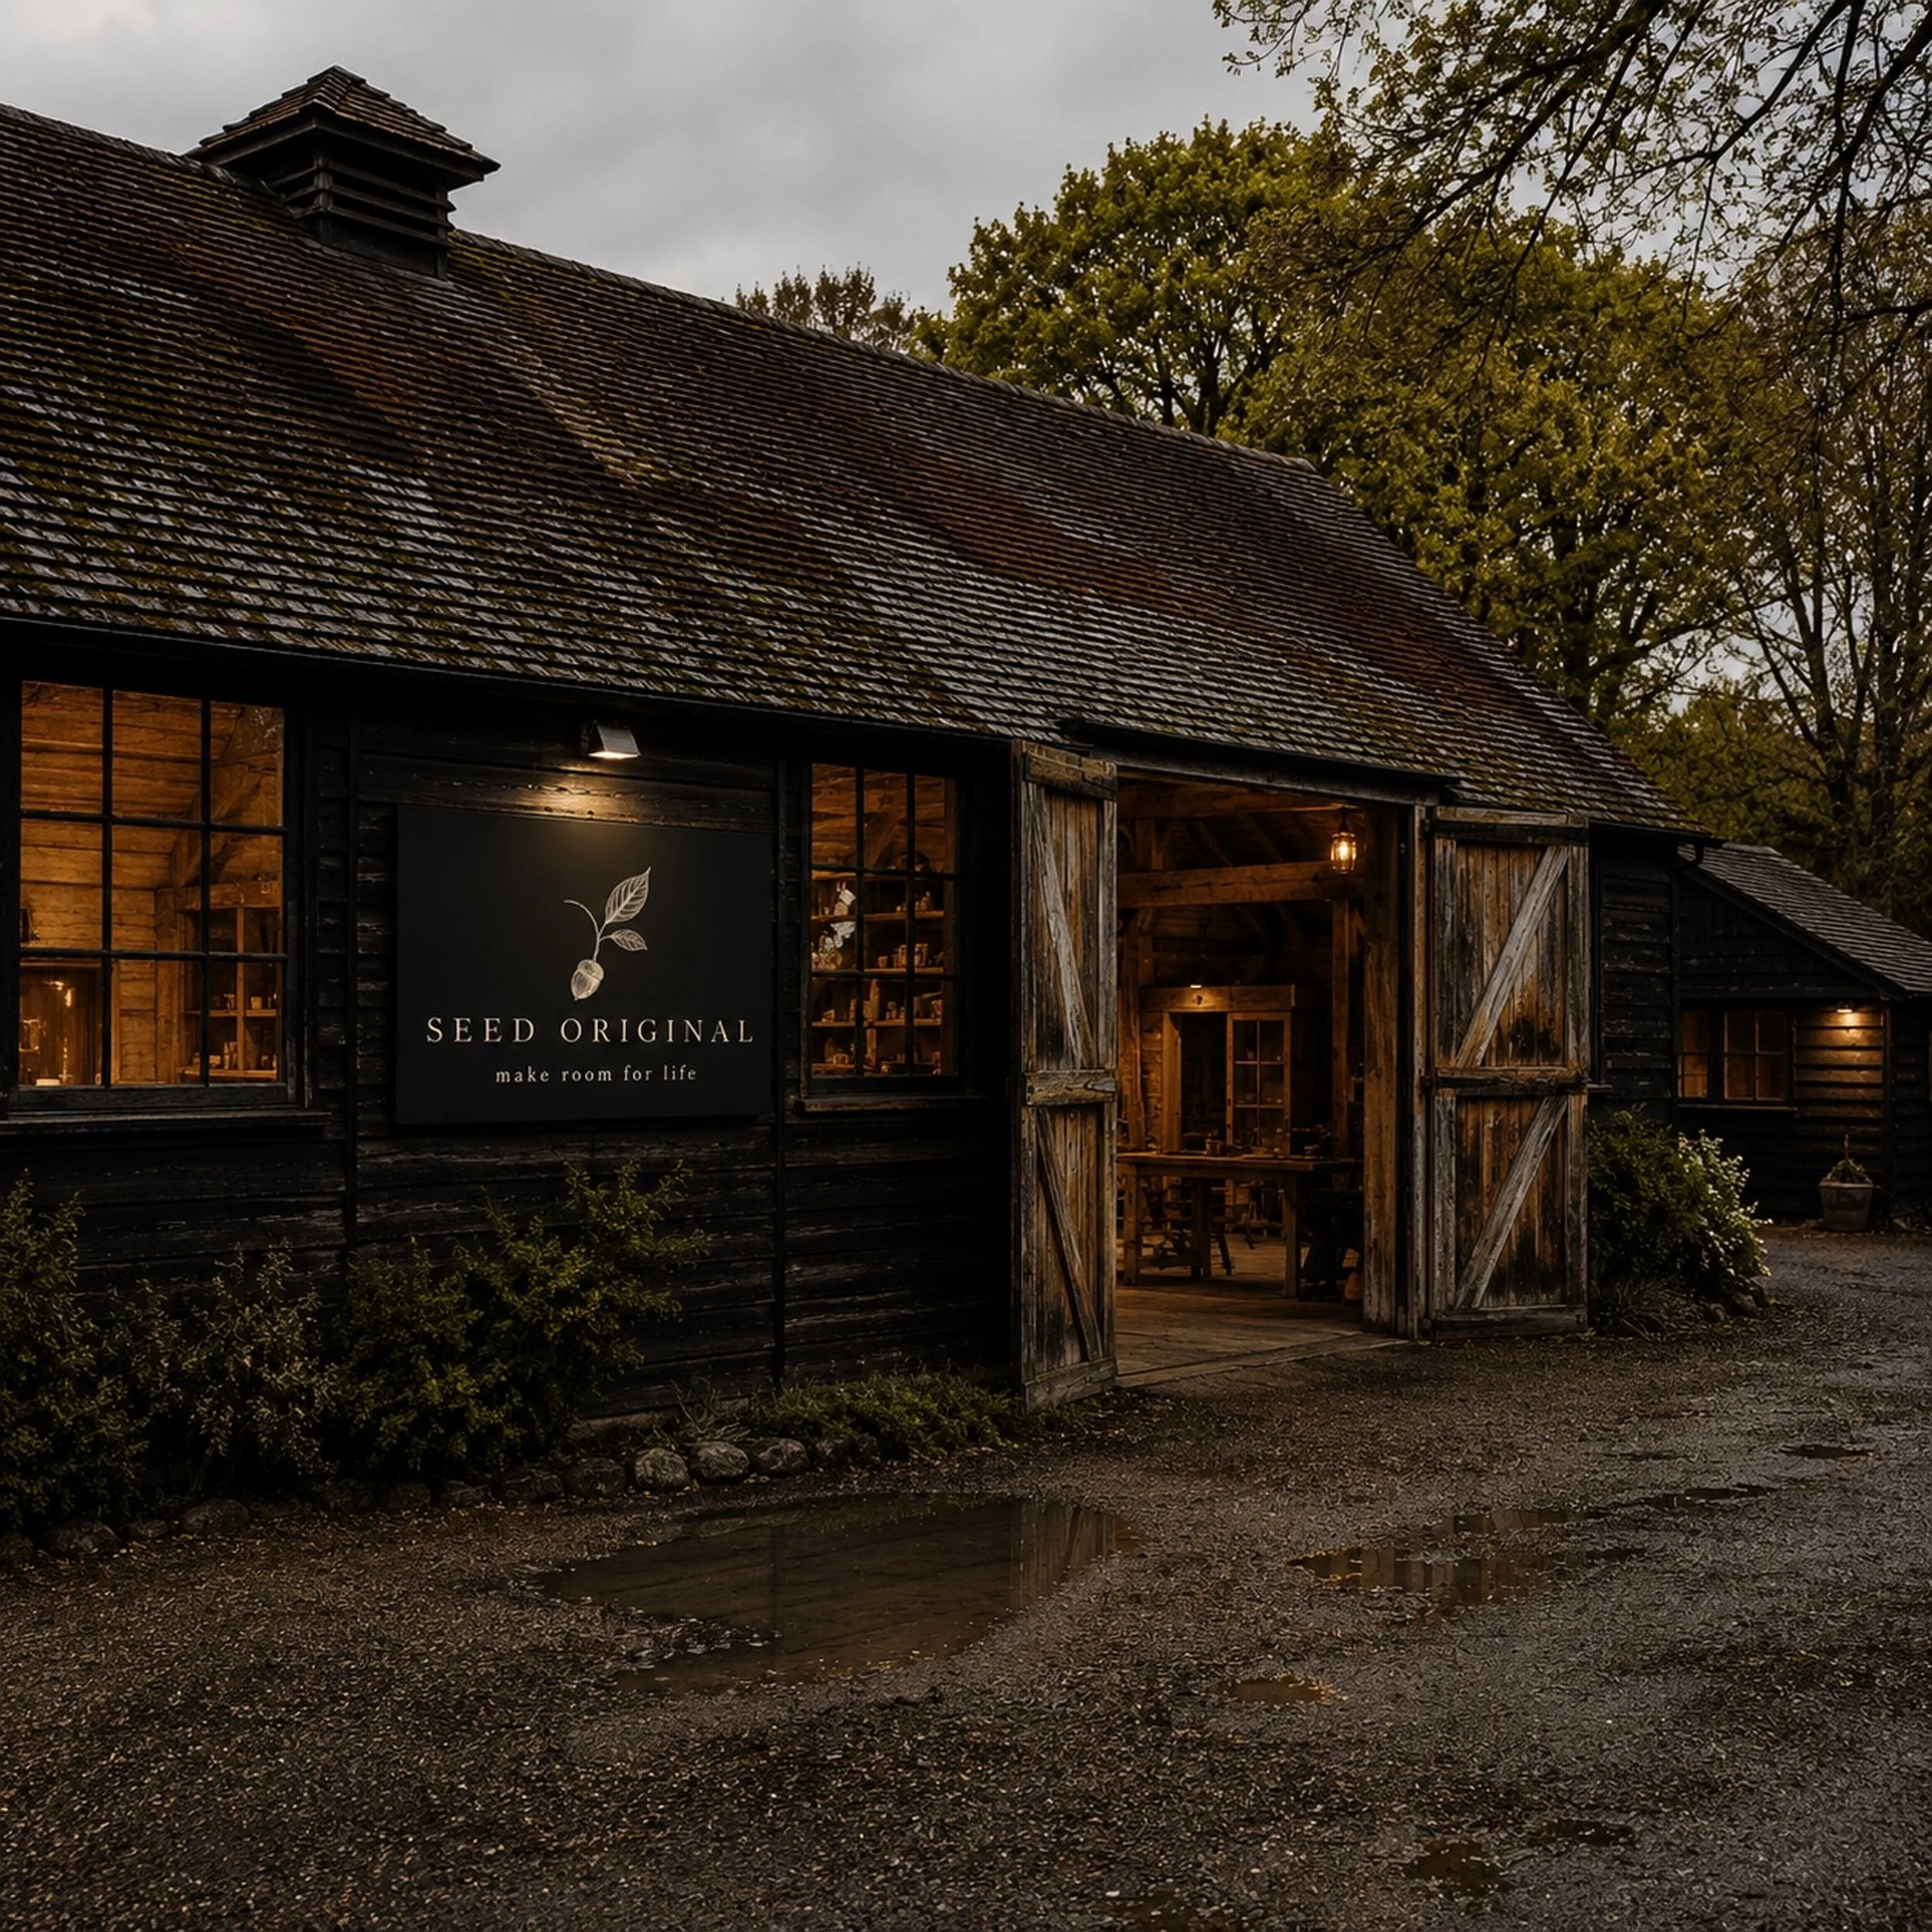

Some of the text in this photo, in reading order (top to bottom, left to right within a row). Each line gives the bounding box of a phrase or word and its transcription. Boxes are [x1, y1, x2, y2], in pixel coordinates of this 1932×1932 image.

[426, 1016, 753, 1043] SEED ORIGINAL
[495, 1064, 696, 1082] make room for life
